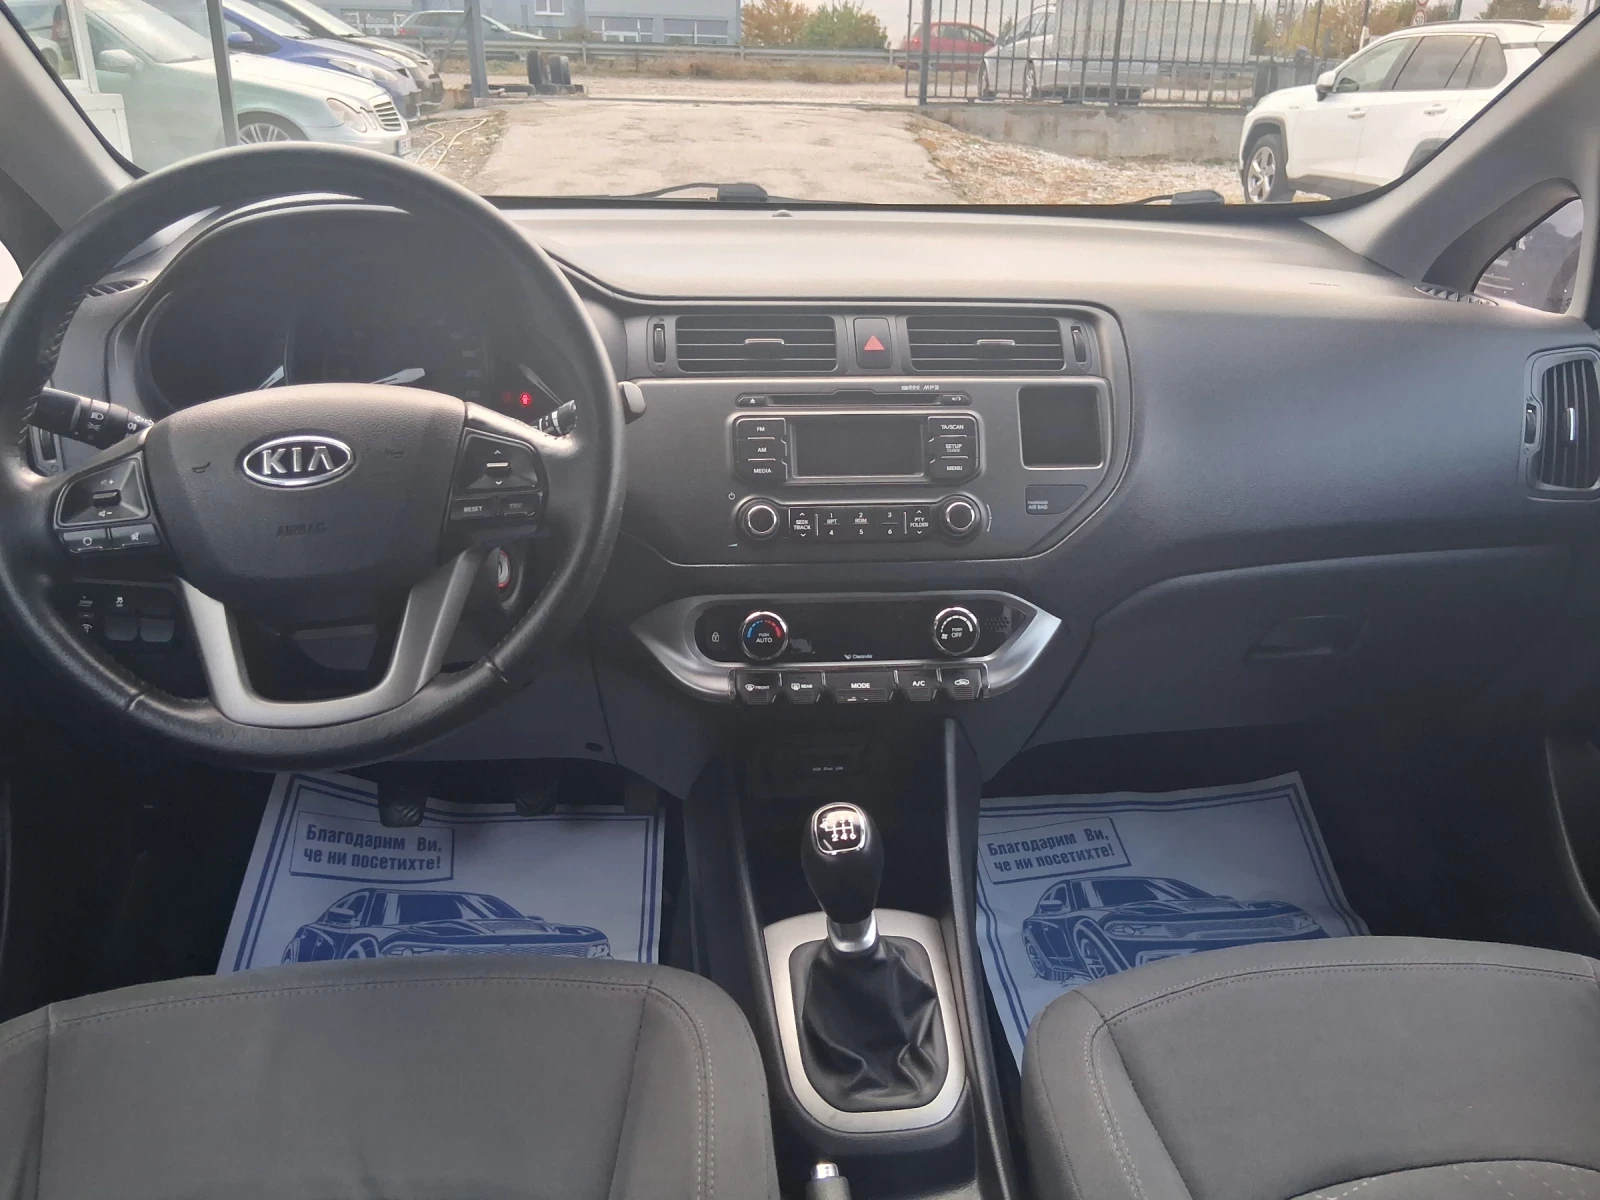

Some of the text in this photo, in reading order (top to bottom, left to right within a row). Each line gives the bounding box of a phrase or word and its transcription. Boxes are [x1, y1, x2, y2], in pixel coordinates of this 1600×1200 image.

[262, 446, 334, 475] KIA
[306, 824, 442, 853] Благодарим Ви,
[831, 833, 839, 842] 2
[840, 832, 848, 840] 4
[986, 828, 1110, 856] Благодарим Ви,
[303, 847, 441, 871] че ни посетихте!
[993, 843, 1116, 873] че ни посетихте!
